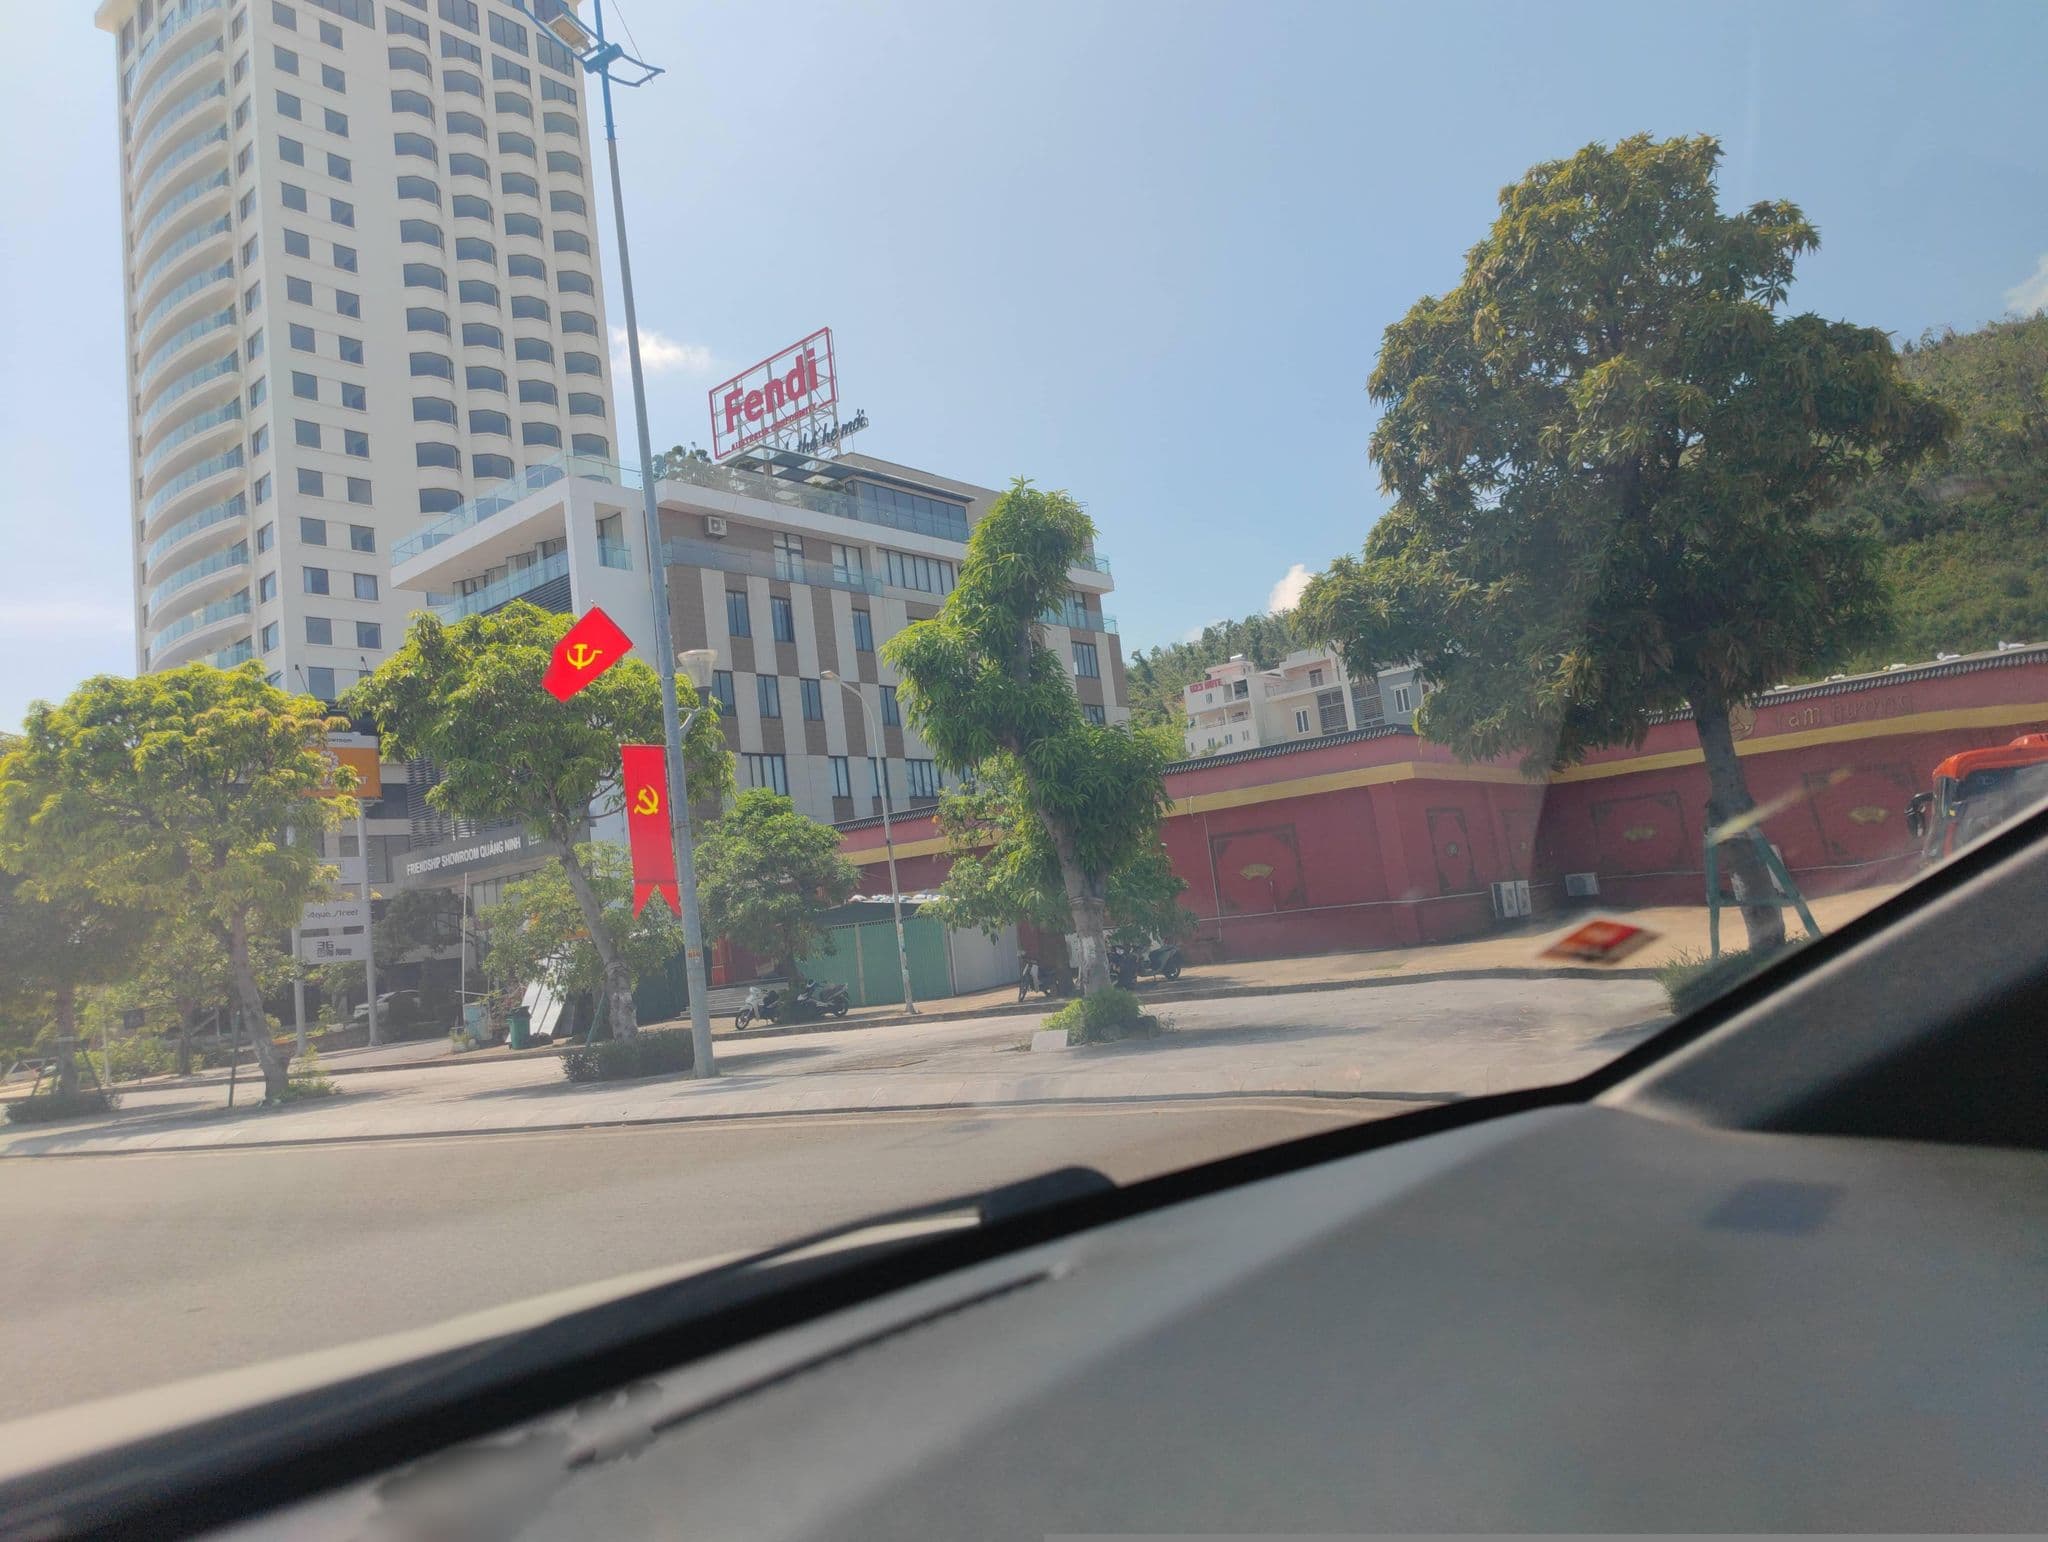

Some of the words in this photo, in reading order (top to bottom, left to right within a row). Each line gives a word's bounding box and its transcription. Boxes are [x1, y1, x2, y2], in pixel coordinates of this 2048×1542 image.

[724, 348, 819, 434] Fendi
[407, 856, 442, 876] FRIENDSHIP
[441, 847, 480, 868] SHOWROOM
[504, 836, 522, 852] NINH
